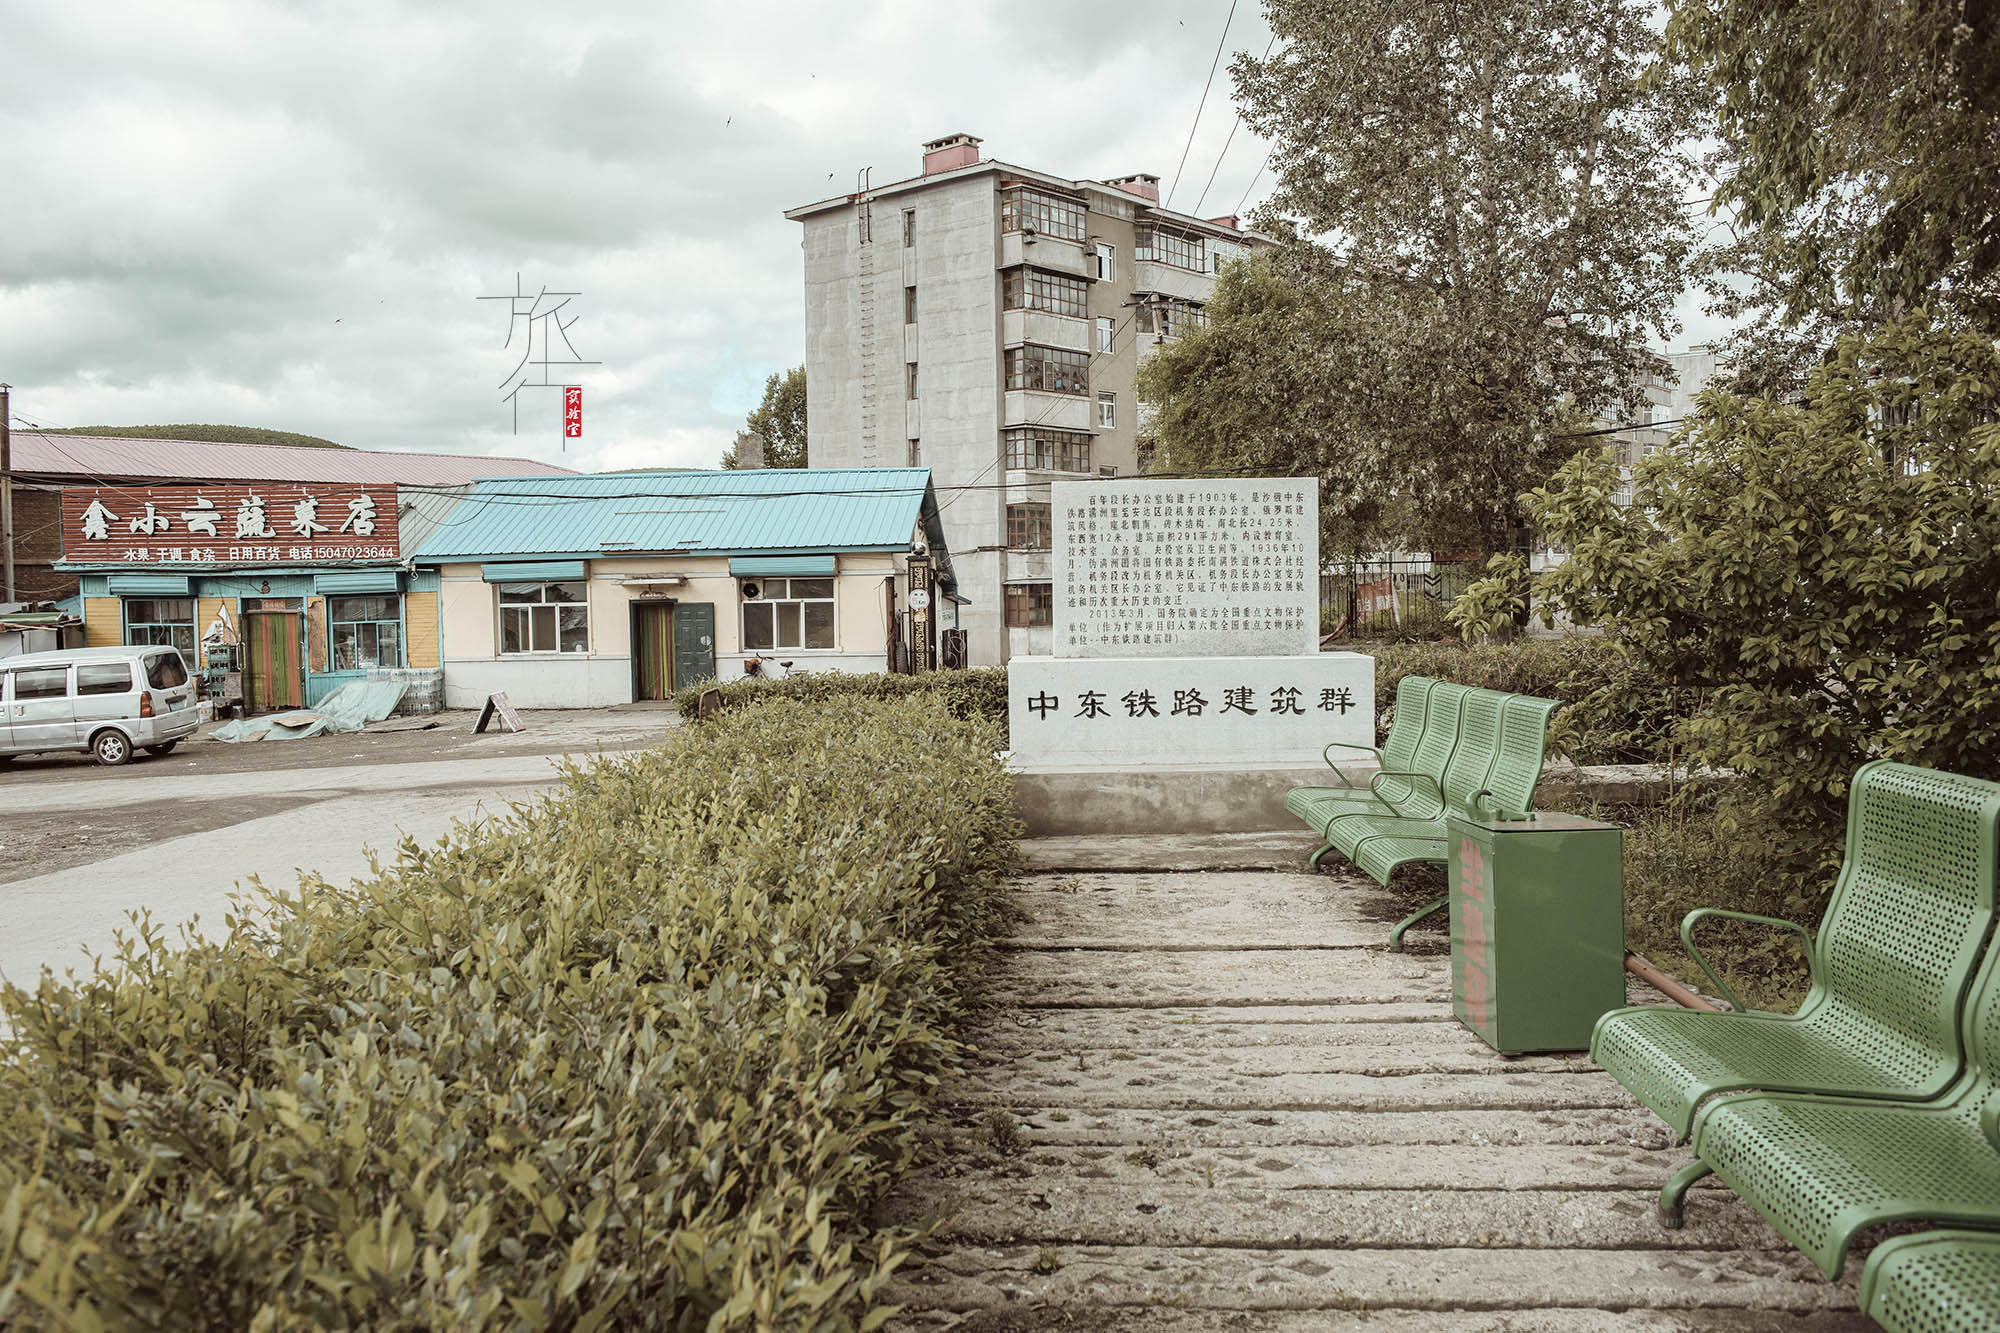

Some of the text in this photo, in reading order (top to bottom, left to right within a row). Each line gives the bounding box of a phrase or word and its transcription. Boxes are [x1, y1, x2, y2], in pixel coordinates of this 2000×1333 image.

[80, 494, 377, 540] 鑫小云蔬菜店
[123, 548, 150, 561] 水果
[156, 548, 182, 561] 干调
[189, 548, 216, 561] 食杂
[229, 547, 281, 560] 日用百货
[1028, 685, 1356, 721] 中东铁路建筑群
